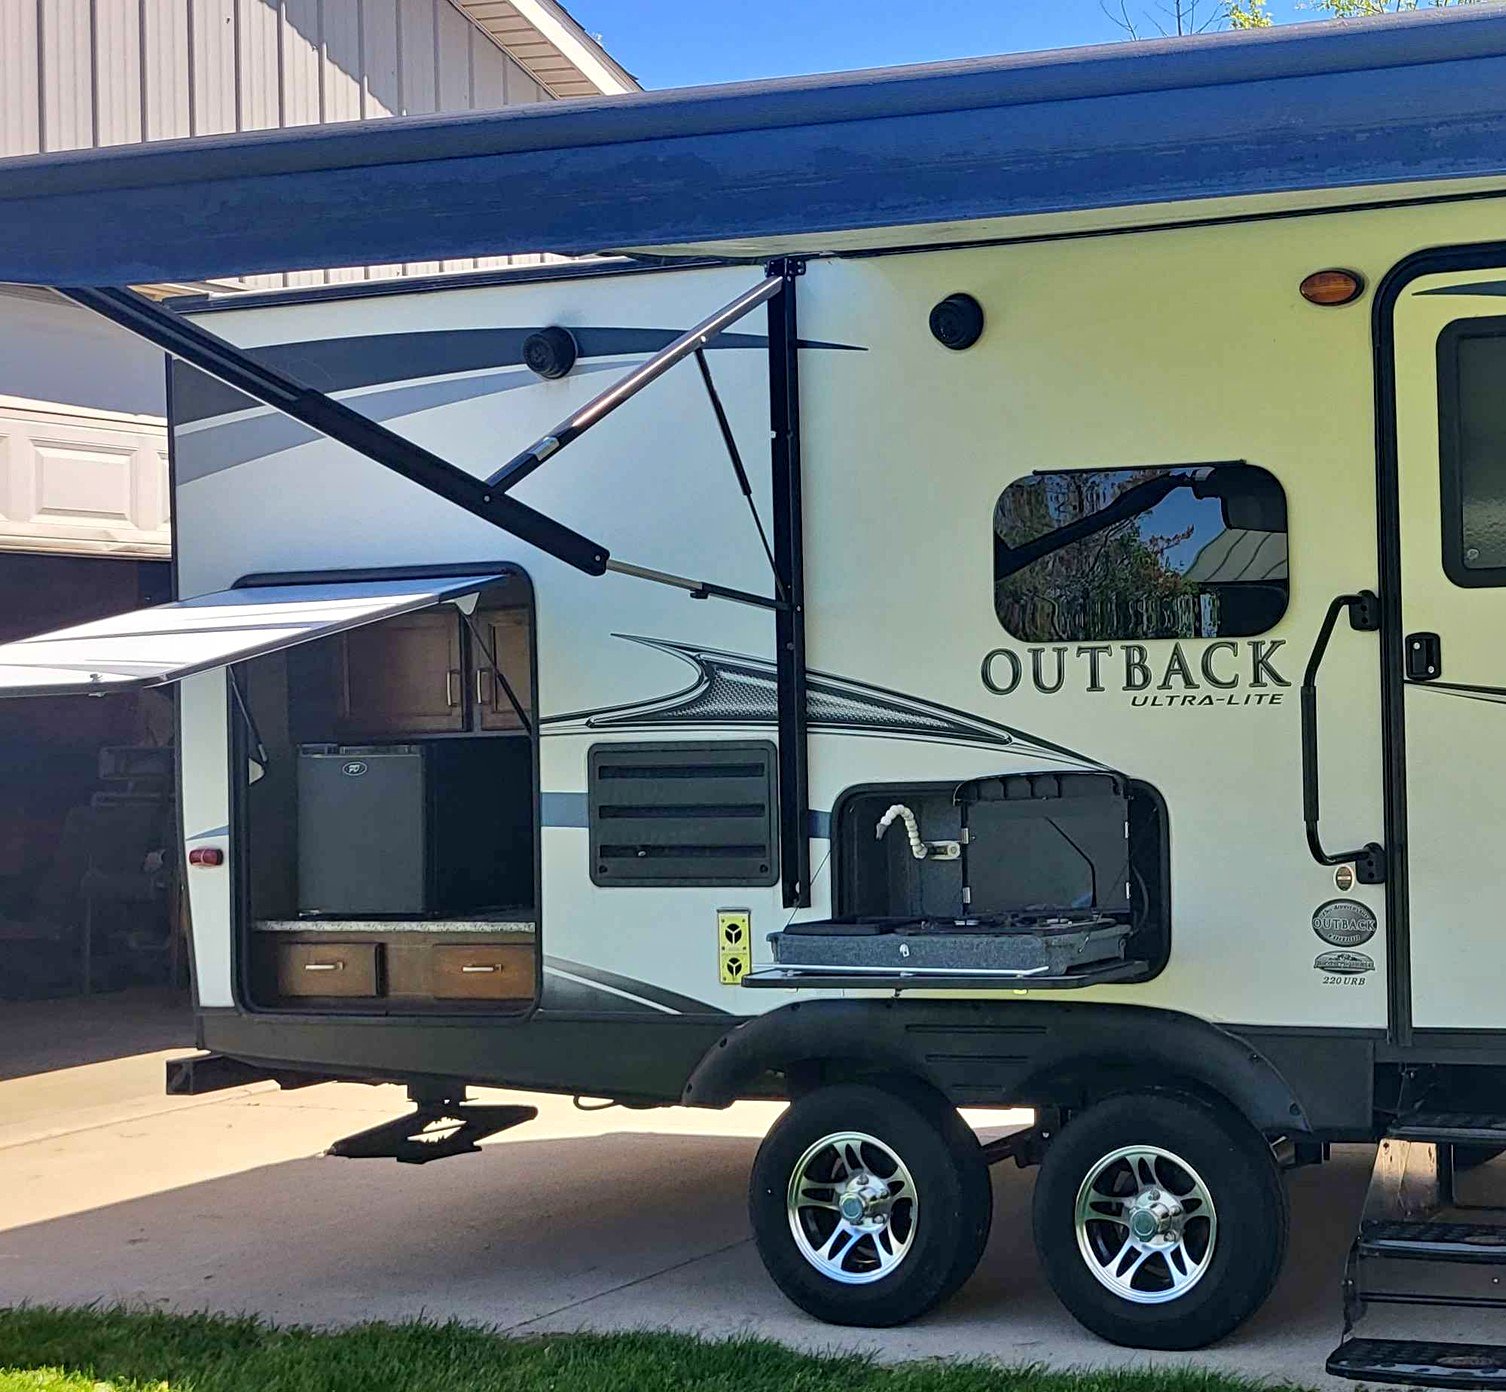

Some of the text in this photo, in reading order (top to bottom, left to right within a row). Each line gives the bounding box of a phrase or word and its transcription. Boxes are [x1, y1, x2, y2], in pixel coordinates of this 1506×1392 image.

[981, 639, 1291, 695] OUTBACK
[1131, 694, 1284, 707] ULTRA-LITE
[1313, 918, 1375, 931] OUTBACK
